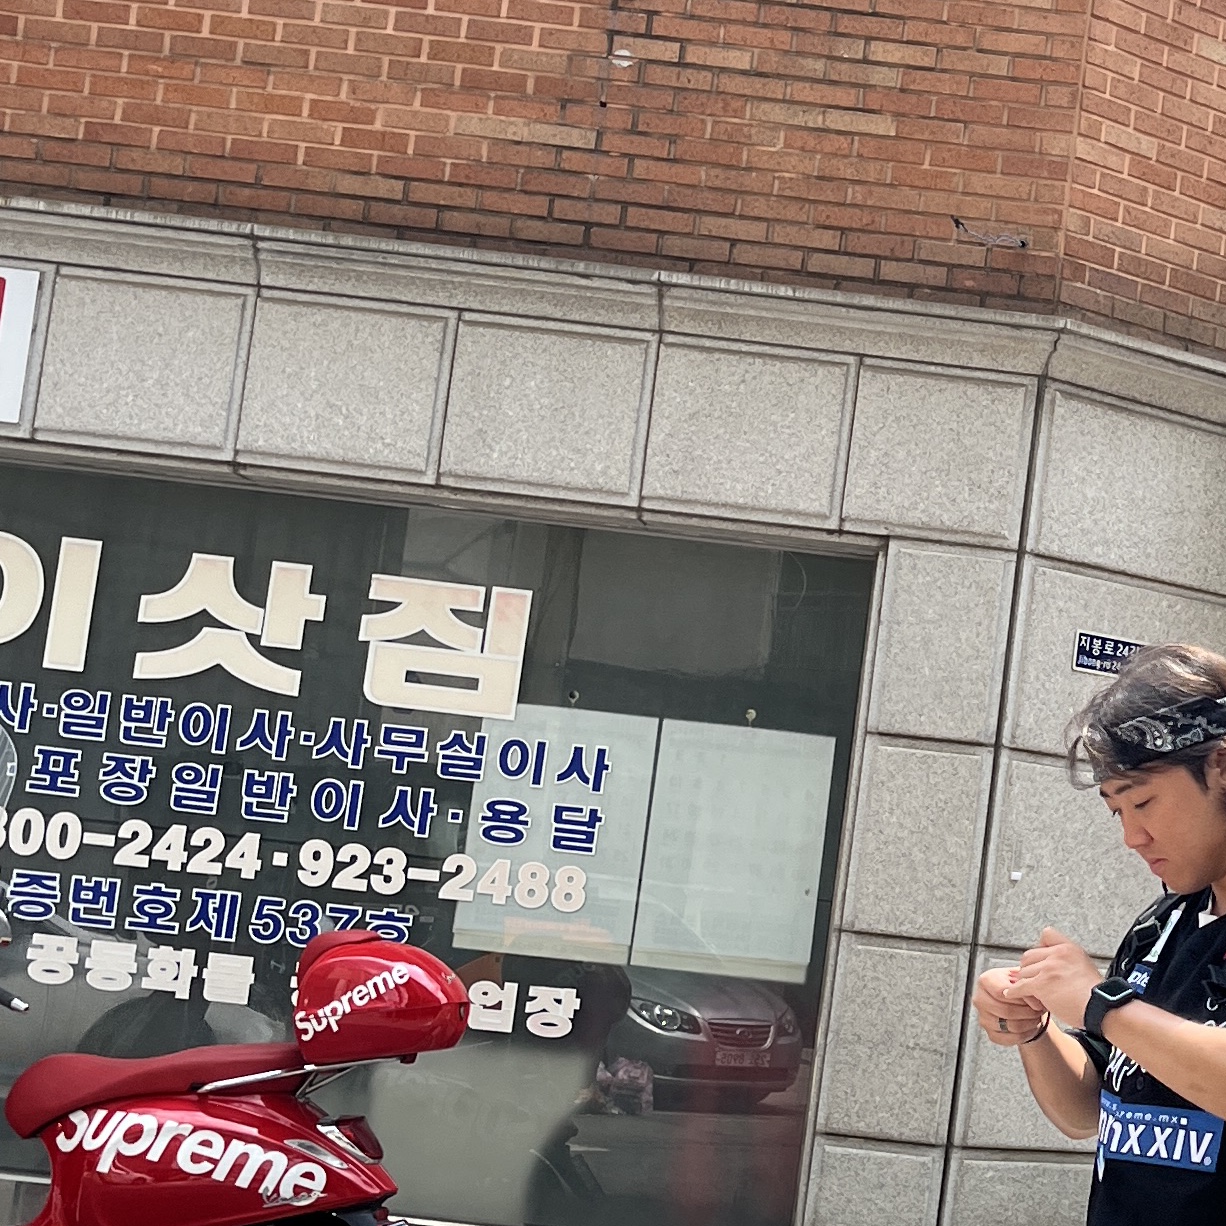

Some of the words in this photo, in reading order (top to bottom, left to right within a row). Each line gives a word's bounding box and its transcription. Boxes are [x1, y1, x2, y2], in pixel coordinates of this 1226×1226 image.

[0, 531, 533, 721] 이삿짐
[0, 806, 587, 912] 00-2424·923-2488
[295, 965, 410, 1042] Supreme
[56, 1109, 327, 1206] Supreme
